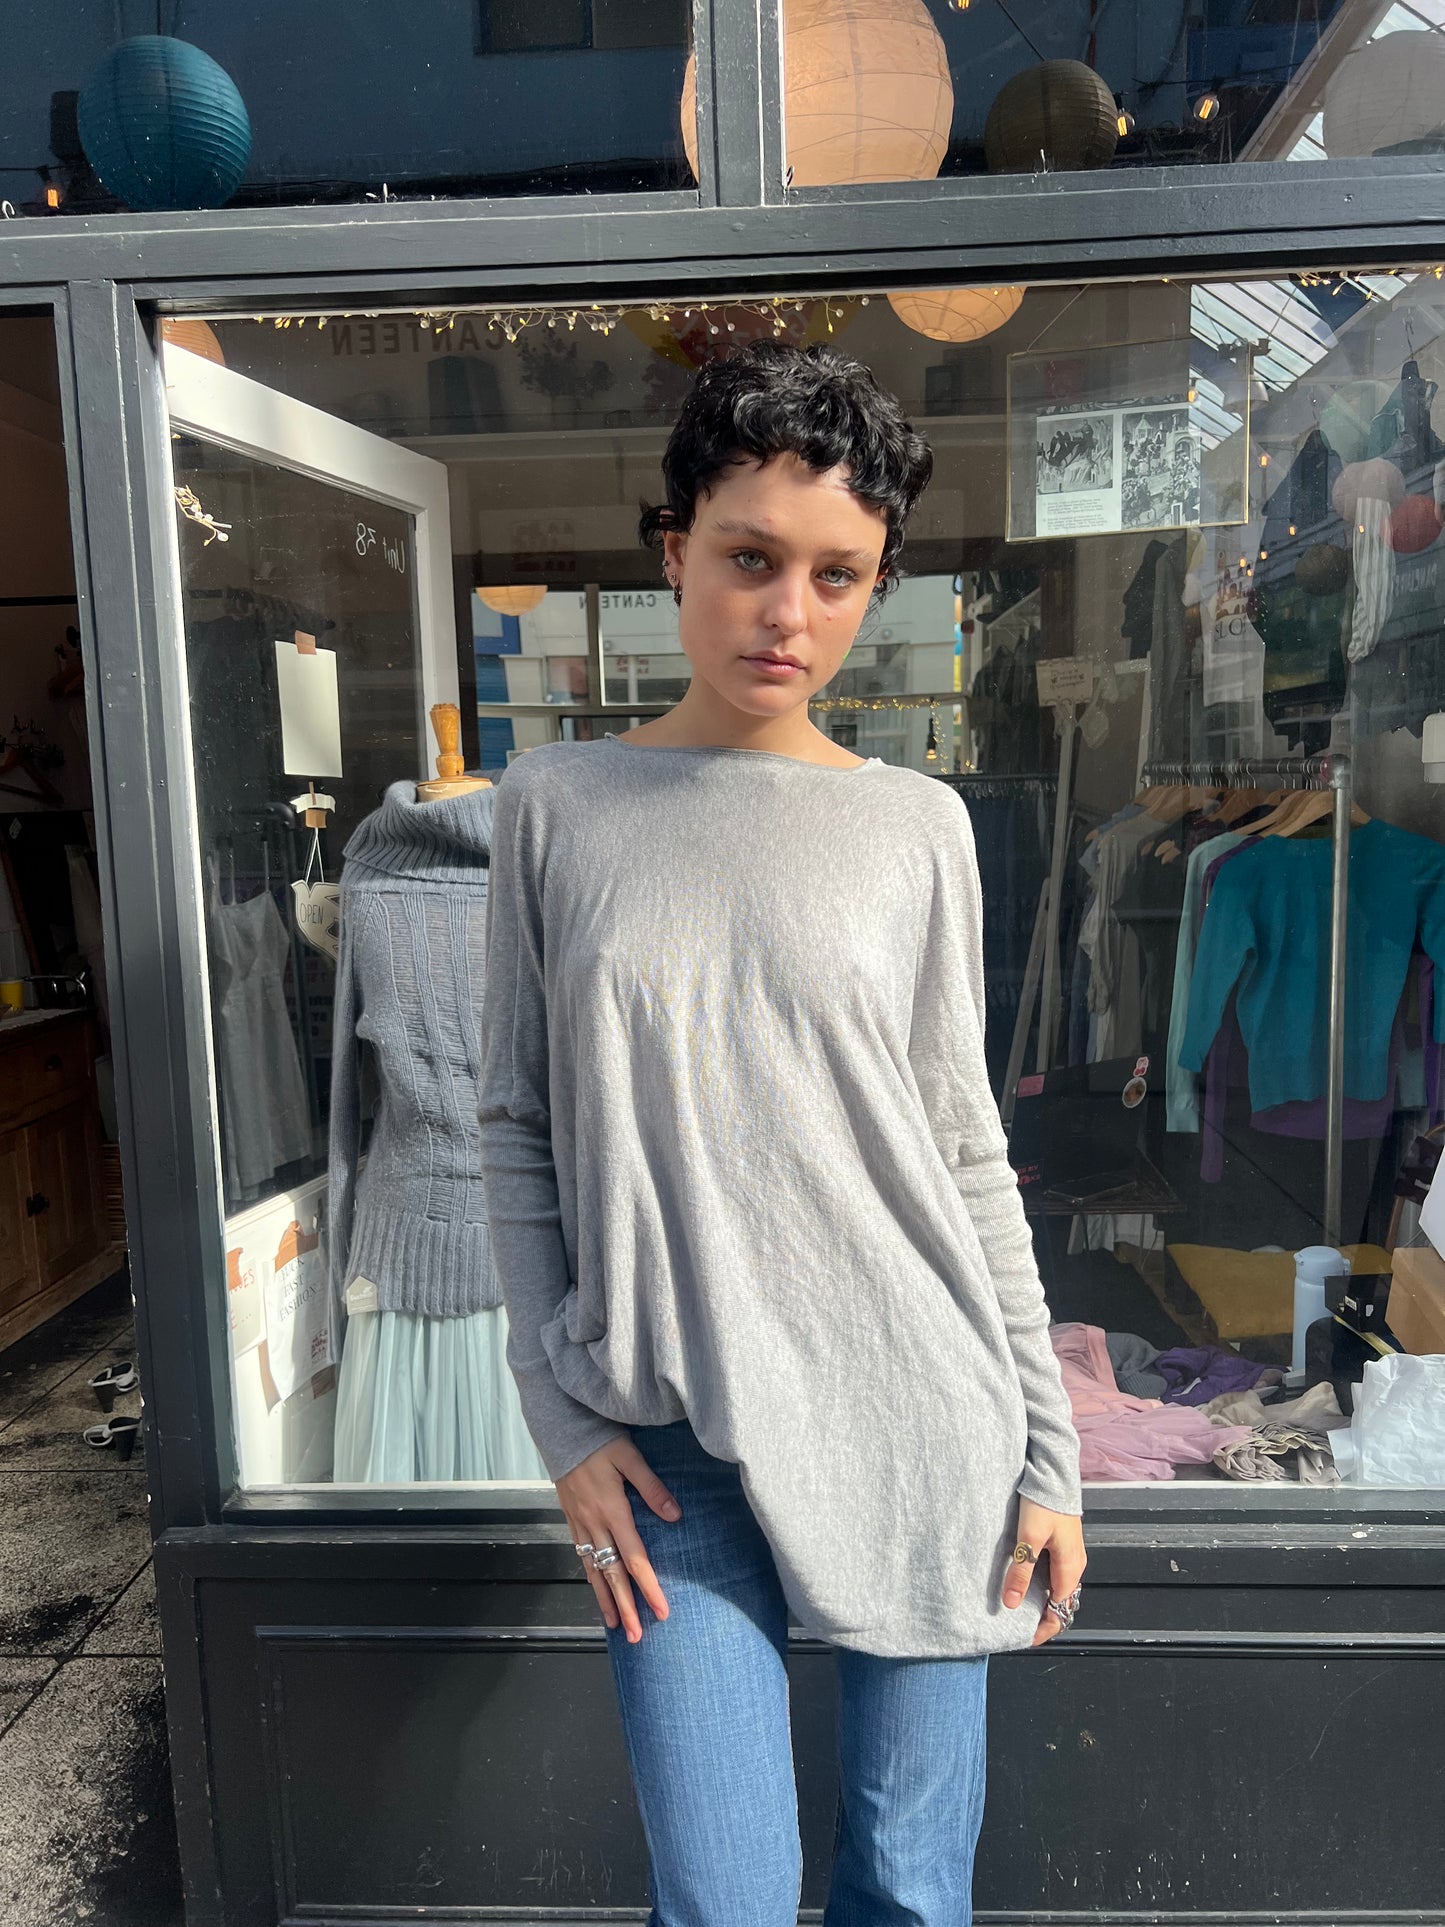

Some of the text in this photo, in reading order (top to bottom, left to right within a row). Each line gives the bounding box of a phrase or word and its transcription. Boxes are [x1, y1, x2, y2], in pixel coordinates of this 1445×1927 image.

[300, 902, 324, 925] OPEN
[283, 1272, 305, 1298] FAST
[279, 1283, 320, 1322] FASHION
